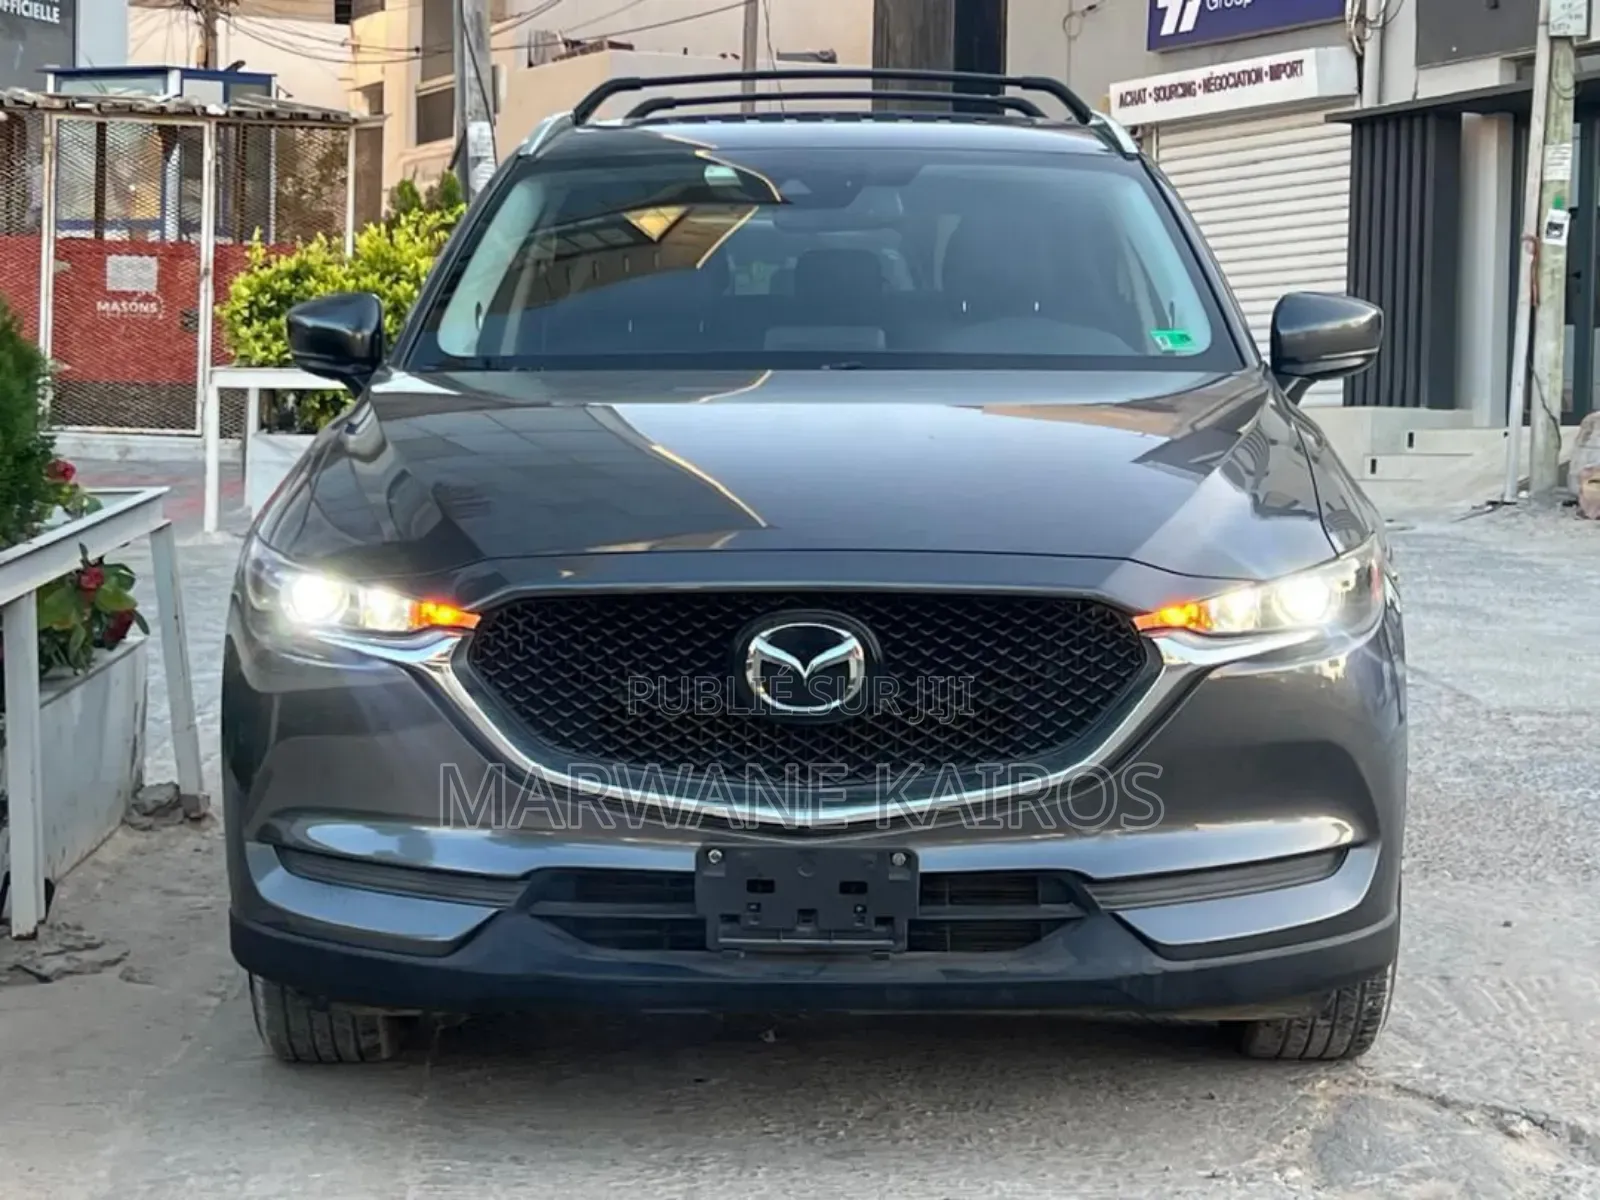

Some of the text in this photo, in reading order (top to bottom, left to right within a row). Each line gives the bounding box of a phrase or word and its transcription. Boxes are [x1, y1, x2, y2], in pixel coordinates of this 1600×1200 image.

[0, 0, 60, 24] FFICIELLE
[1119, 87, 1147, 109] ACHAT
[1153, 80, 1197, 103] SOURCING
[1269, 59, 1304, 82] IMPORT
